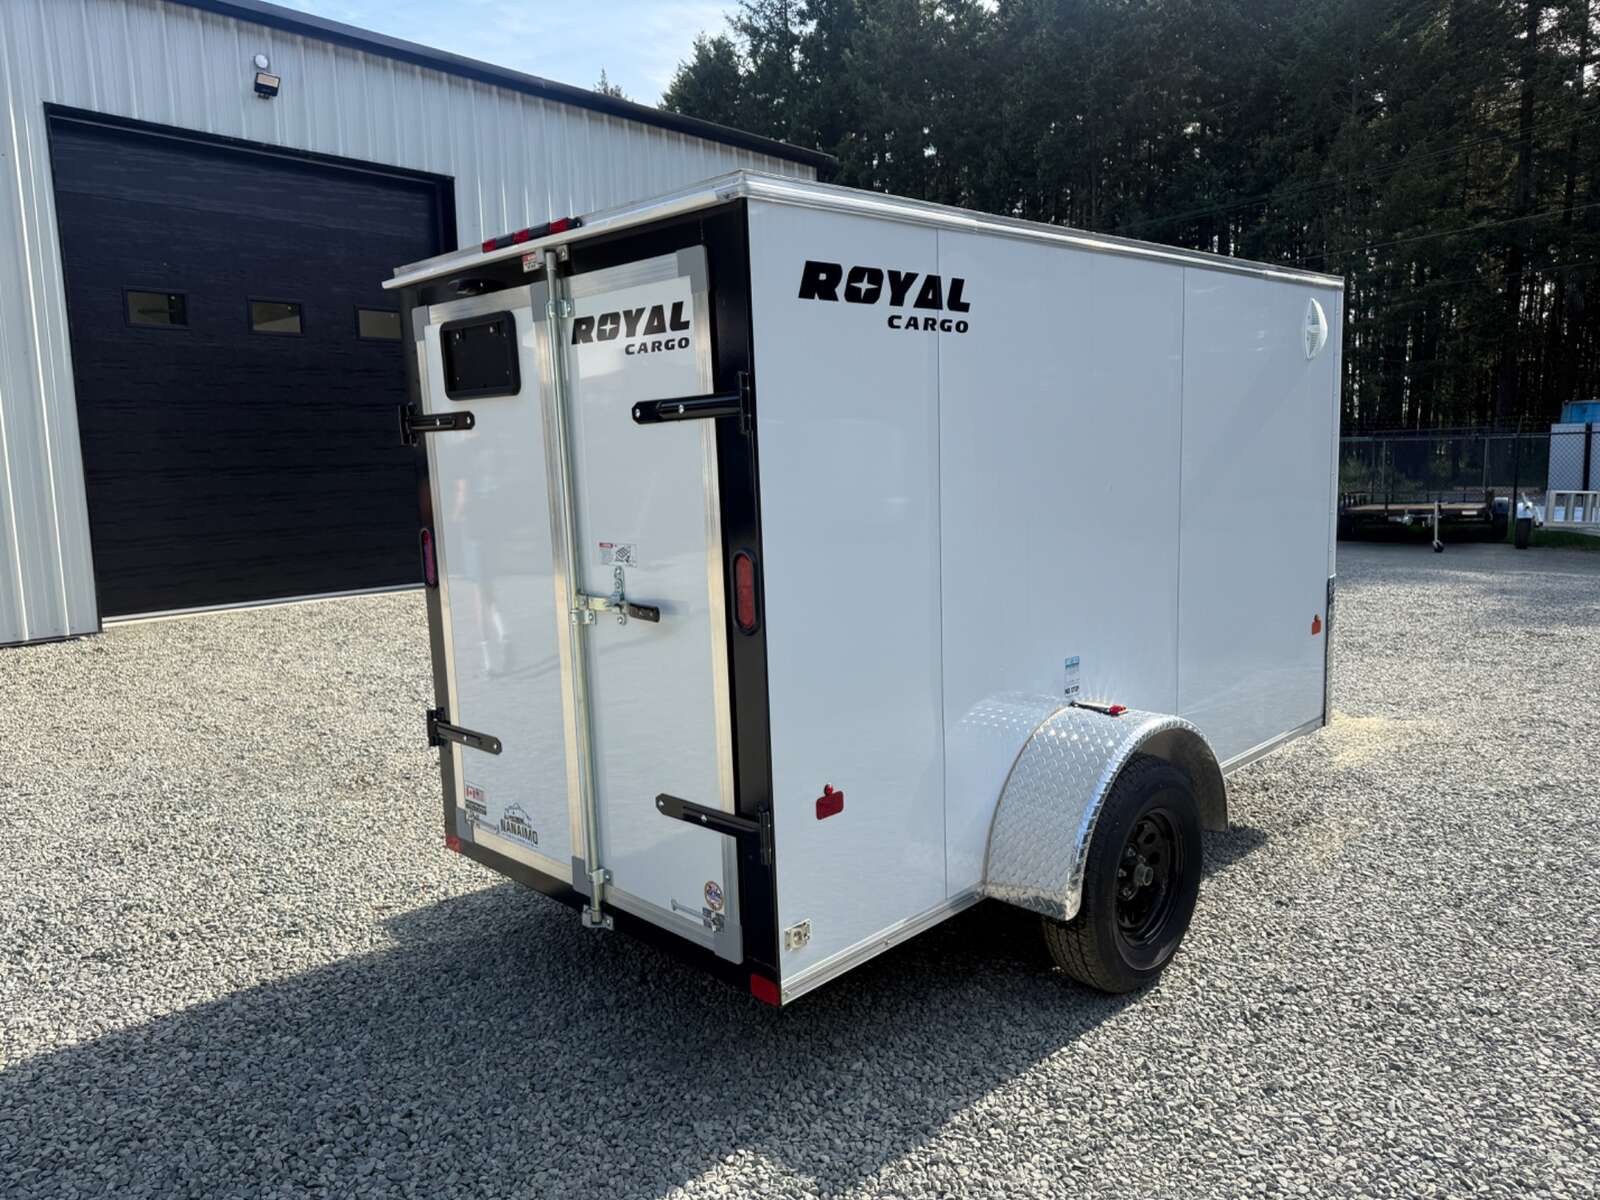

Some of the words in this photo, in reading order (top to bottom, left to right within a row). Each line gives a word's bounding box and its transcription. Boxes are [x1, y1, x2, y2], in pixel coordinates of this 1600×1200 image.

[798, 260, 970, 313] ROYAL
[571, 301, 690, 345] ROYAL
[887, 314, 969, 333] CARGO
[624, 337, 690, 355] CARGO
[500, 818, 538, 845] NANAIMO
